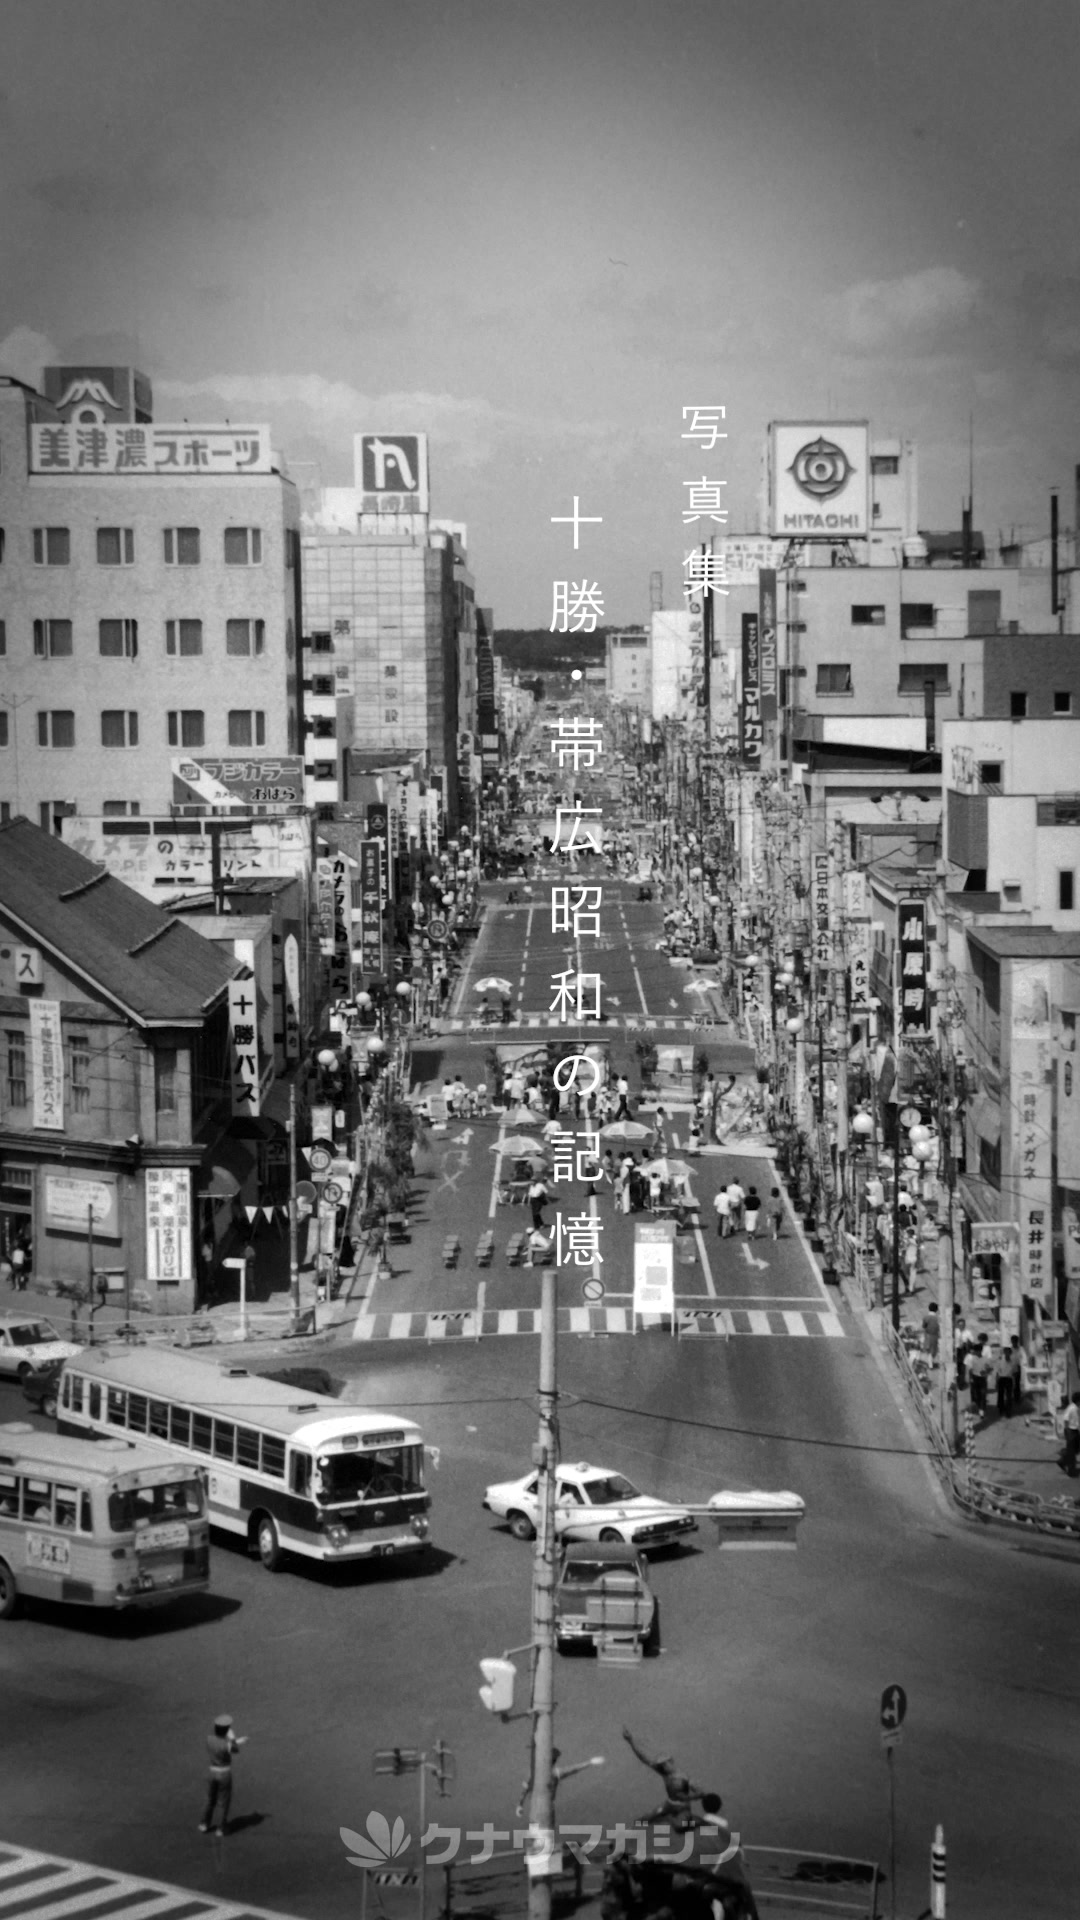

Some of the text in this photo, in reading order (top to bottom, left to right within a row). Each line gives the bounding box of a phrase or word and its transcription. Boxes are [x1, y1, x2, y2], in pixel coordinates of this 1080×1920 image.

[784, 513, 859, 529] HITACHI
[743, 687, 763, 757] マルカワ
[202, 762, 300, 781] フジカラー
[165, 859, 262, 873] カラーリント
[18, 952, 36, 979] ス
[232, 994, 259, 1104] 十勝バス
